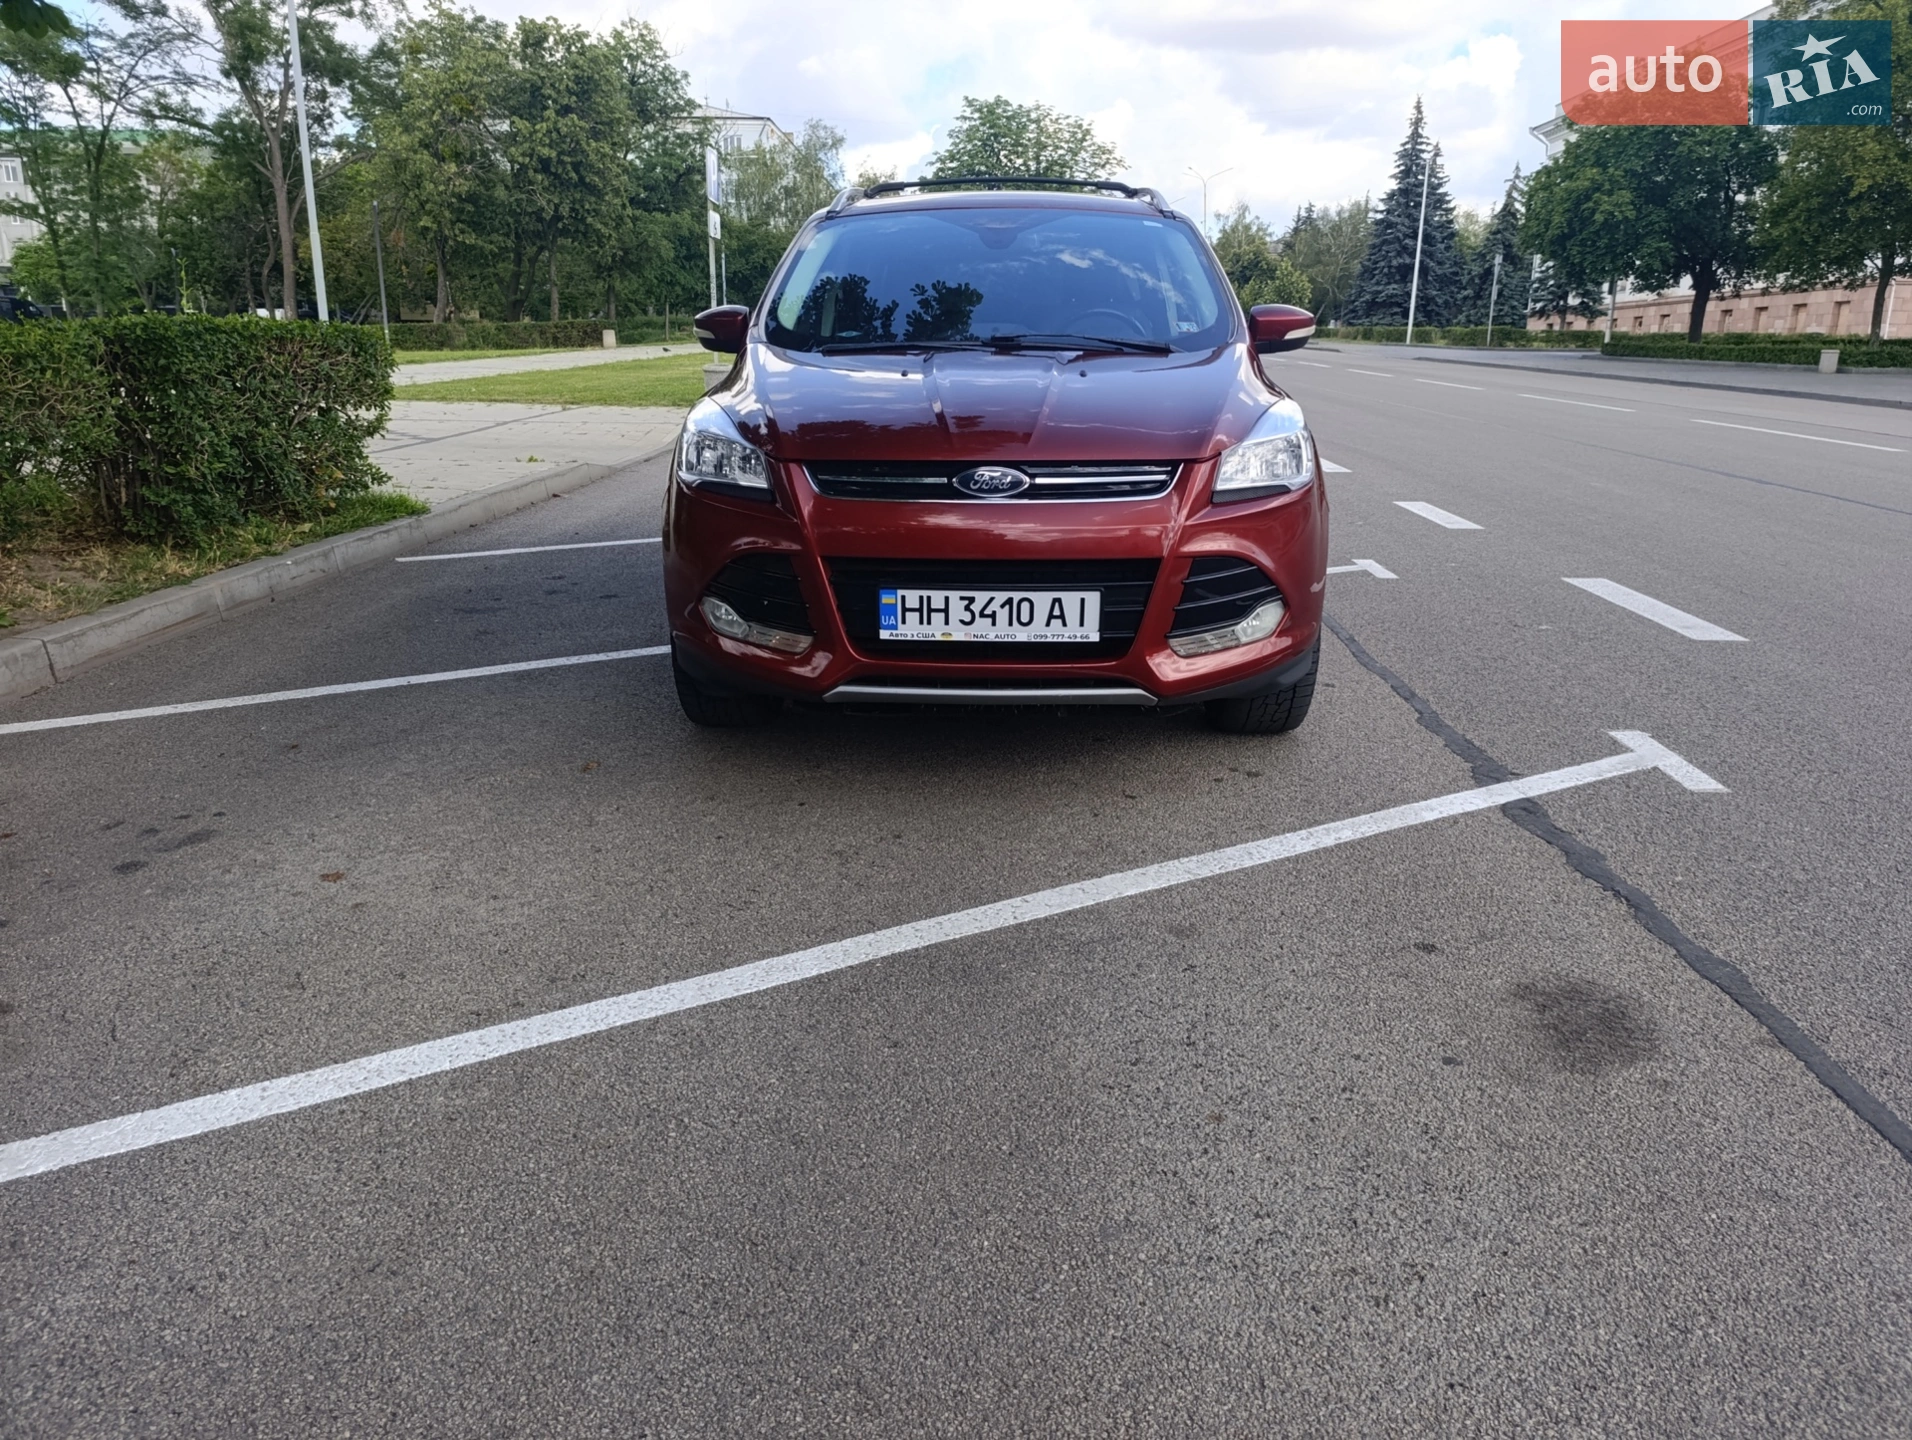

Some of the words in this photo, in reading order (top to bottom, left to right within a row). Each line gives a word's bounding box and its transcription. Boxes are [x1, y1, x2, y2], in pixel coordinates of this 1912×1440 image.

[969, 471, 1012, 490] Ford
[901, 594, 950, 626] HH
[958, 596, 1035, 627] 3410
[881, 615, 897, 626] UA
[888, 631, 908, 639] Авто
[916, 631, 936, 639] США
